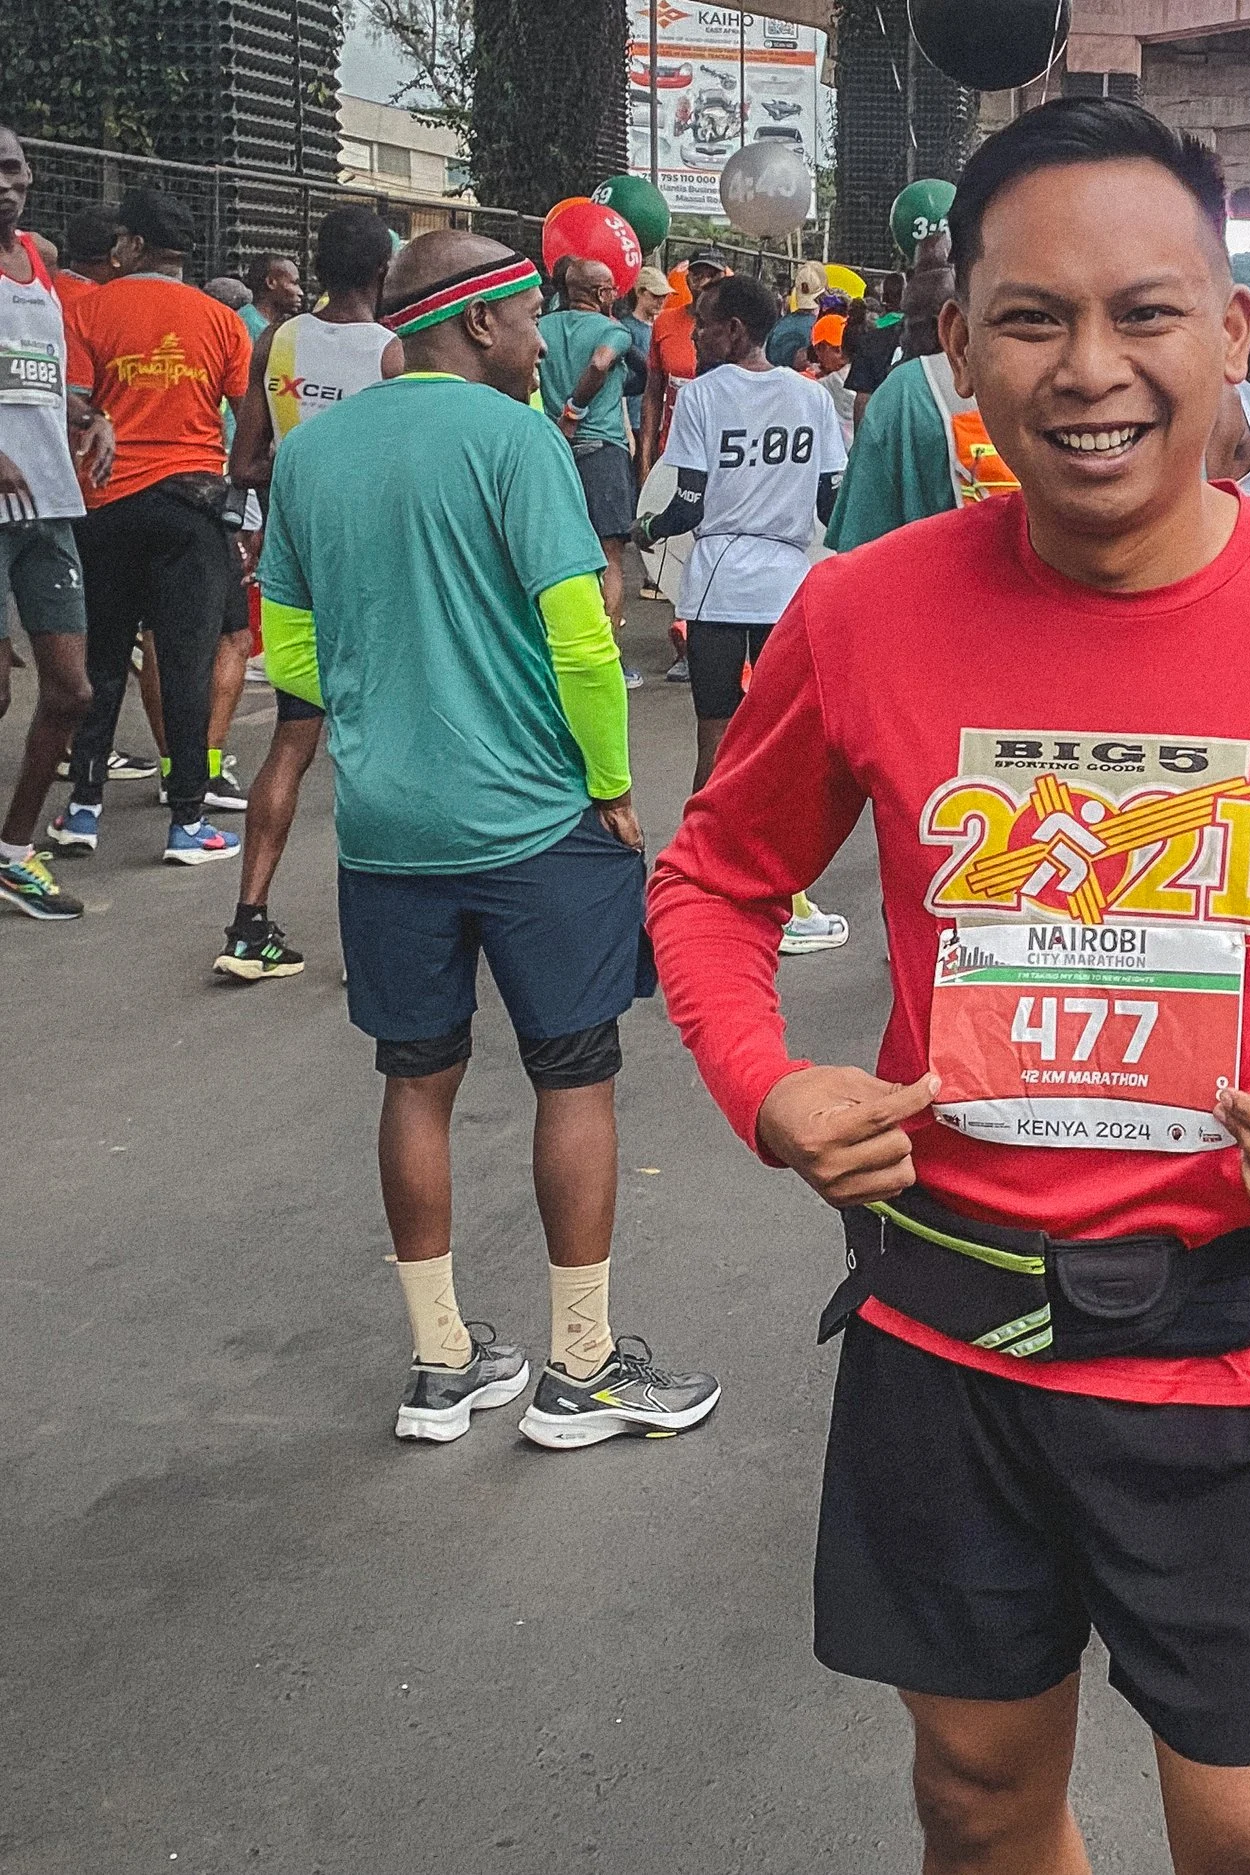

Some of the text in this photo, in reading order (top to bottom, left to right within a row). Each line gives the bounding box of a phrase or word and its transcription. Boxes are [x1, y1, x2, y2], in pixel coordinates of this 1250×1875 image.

[698, 11, 754, 27] KAIHO
[660, 183, 687, 193] tlantis
[680, 174, 695, 184] 110
[696, 175, 717, 185] 000
[604, 216, 639, 267] 3:45
[719, 426, 813, 468] 5:00
[995, 740, 1209, 773] BIG 5
[995, 760, 1146, 773] SPORTING GOODS
[1028, 926, 1147, 954] NAIROBI
[1027, 952, 1146, 968] CITY MARATHON
[1092, 974, 1101, 982] TO
[1102, 974, 1121, 982] NEW
[1011, 997, 1159, 1064] 477
[1020, 1069, 1149, 1088] 42 KM MARATHON
[1017, 1118, 1151, 1141] KENYA 2024
